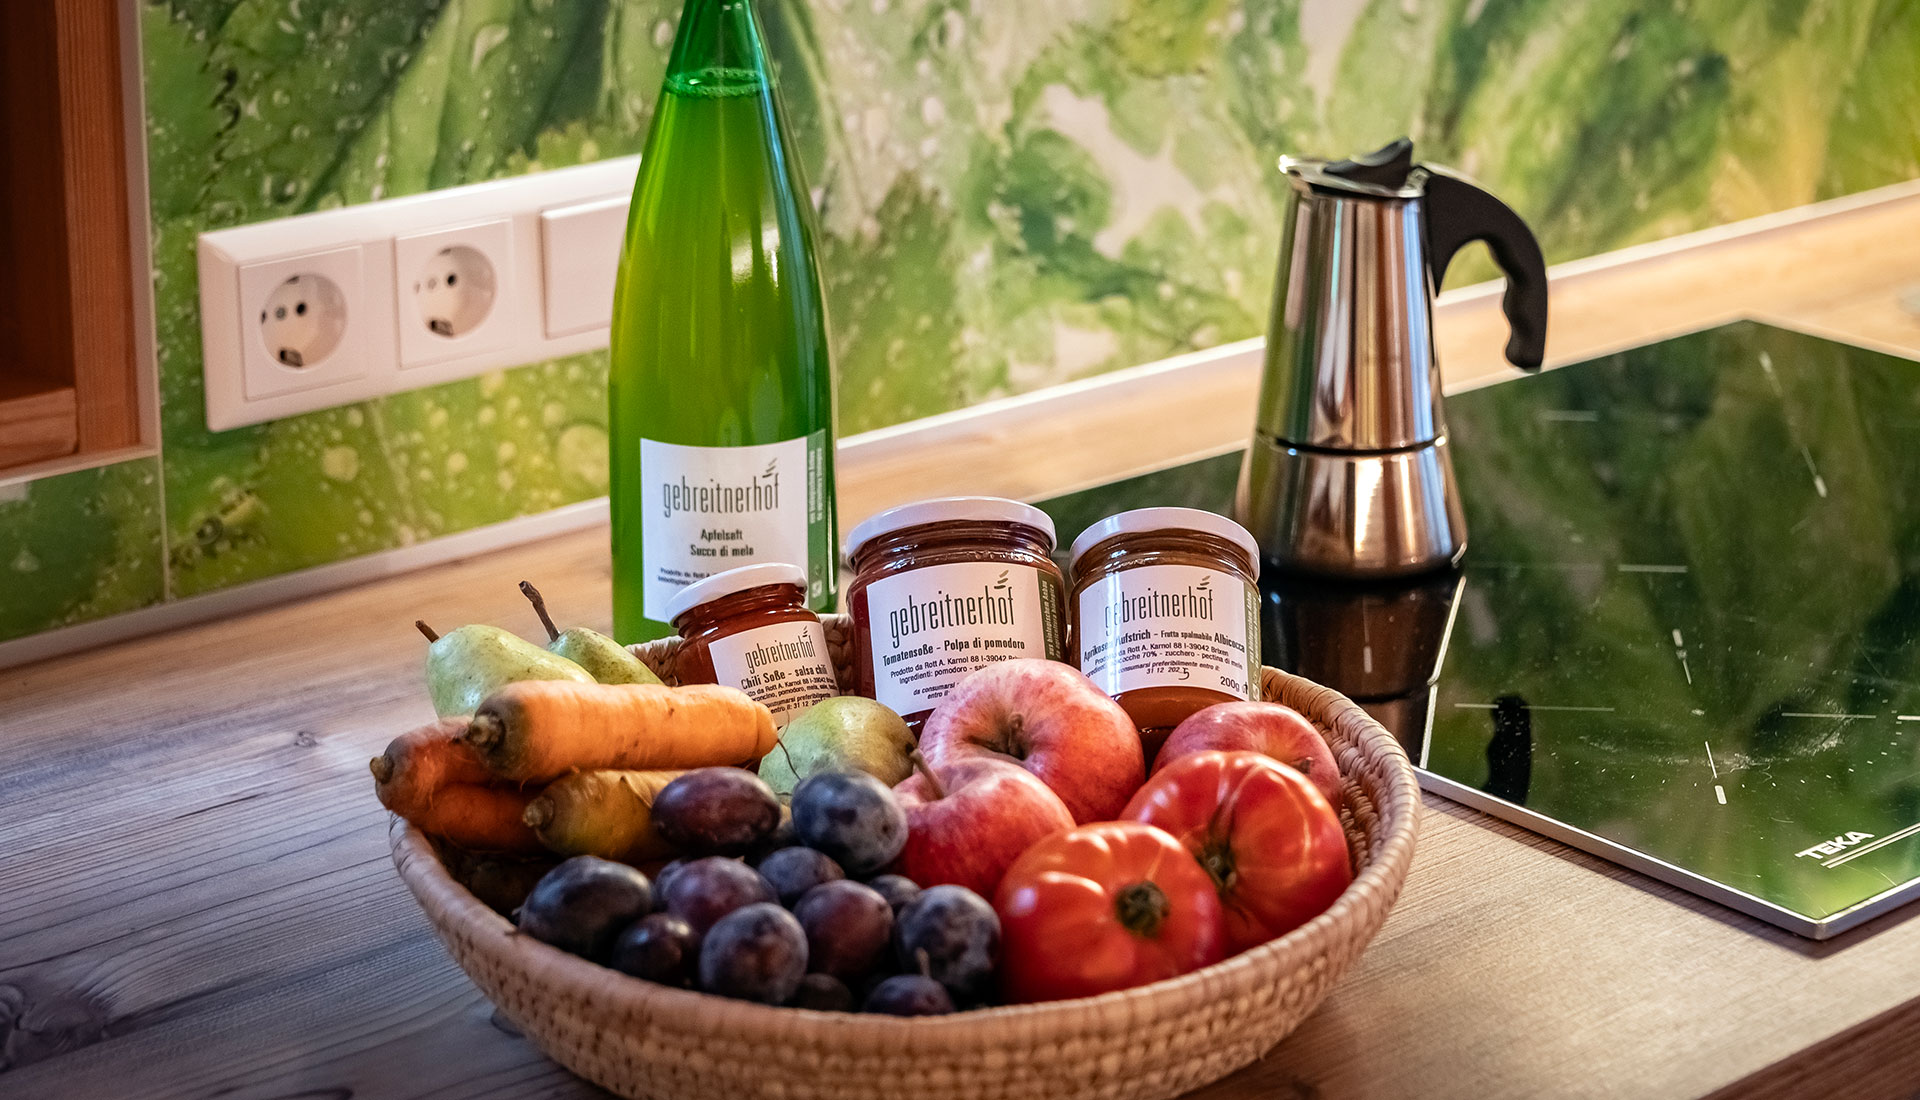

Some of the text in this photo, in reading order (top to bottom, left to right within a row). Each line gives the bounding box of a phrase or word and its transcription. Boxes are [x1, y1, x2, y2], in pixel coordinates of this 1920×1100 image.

[663, 473, 780, 518] gebreitnerhof
[700, 529, 743, 542] Apfelsaft
[720, 544, 728, 558] di
[889, 585, 1015, 649] gebreitnerhof
[1104, 585, 1214, 637] gebreitnerhof
[1127, 644, 1140, 654] Rott
[1150, 642, 1172, 650] Karnol
[1210, 646, 1230, 656] Brixen
[1160, 630, 1179, 638] Frutta
[1181, 631, 1212, 642] spalmabile
[1214, 632, 1245, 653] Albicocca
[745, 635, 816, 674] gebreitnerhof
[882, 643, 934, 667] Tomatensoße
[944, 639, 970, 652] Polpa
[972, 636, 982, 648] di
[984, 637, 1025, 651] pomodoro
[1142, 650, 1158, 658] 70%
[1202, 653, 1224, 662] pectina
[890, 666, 914, 679] Prodotto
[924, 660, 938, 669] Rott
[938, 659, 946, 667] A.
[947, 656, 969, 665] Karnol
[970, 655, 980, 663] 88
[1152, 660, 1198, 668] preferibilmente
[741, 674, 762, 690] Chili
[763, 670, 786, 684] Soße
[794, 665, 815, 677] salsa
[900, 670, 933, 685] Ingredienti:
[934, 666, 968, 678] pomodoro
[1220, 676, 1240, 692] 200g
[766, 684, 778, 693] Rott
[784, 680, 802, 688] Karnol
[913, 682, 956, 696] da consumarsi
[927, 692, 943, 700] entro
[770, 706, 786, 714] entro
[1794, 831, 1875, 860] TEKA
